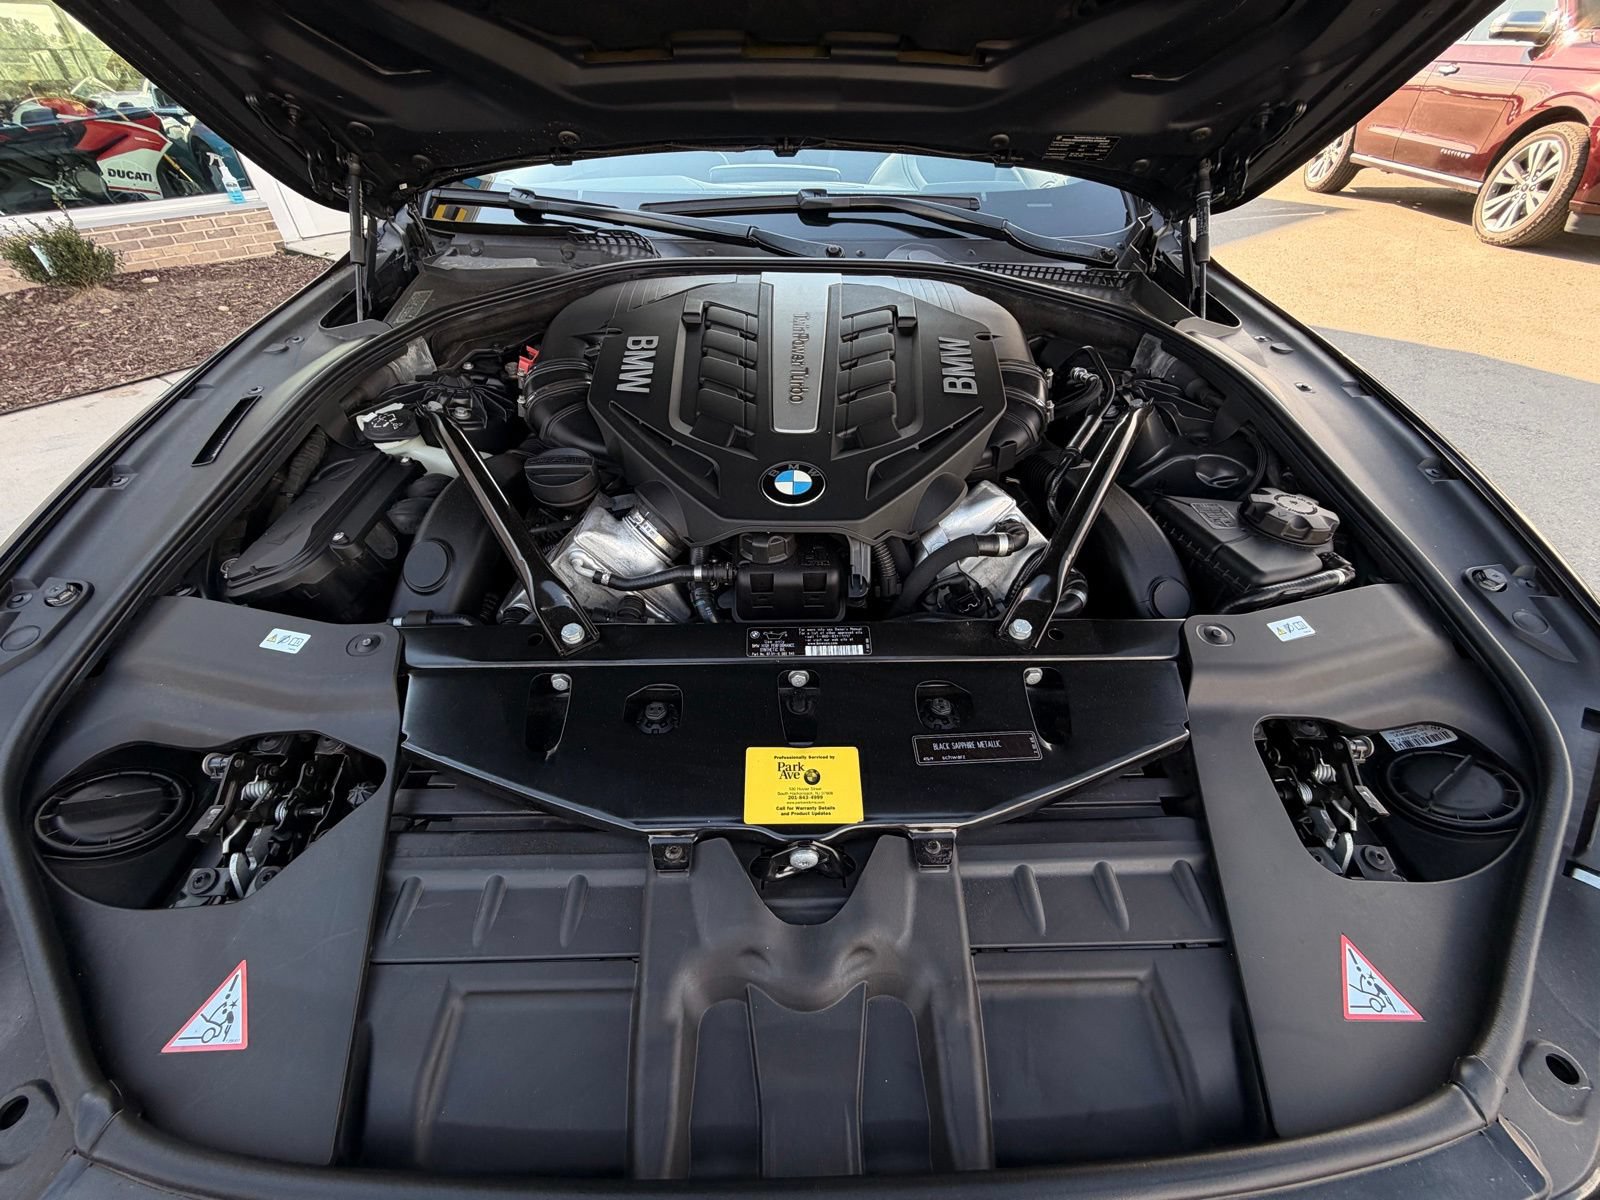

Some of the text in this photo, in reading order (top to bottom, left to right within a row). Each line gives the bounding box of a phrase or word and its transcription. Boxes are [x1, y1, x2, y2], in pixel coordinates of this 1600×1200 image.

[107, 168, 152, 182] DUCATI
[616, 336, 659, 393] BMW
[789, 312, 810, 405] TwinPower Turbo
[938, 336, 978, 394] BMW
[932, 740, 1002, 751] BLACK SAPPHIRE METALLIC
[778, 762, 805, 771] Park
[779, 770, 800, 779] Ave
